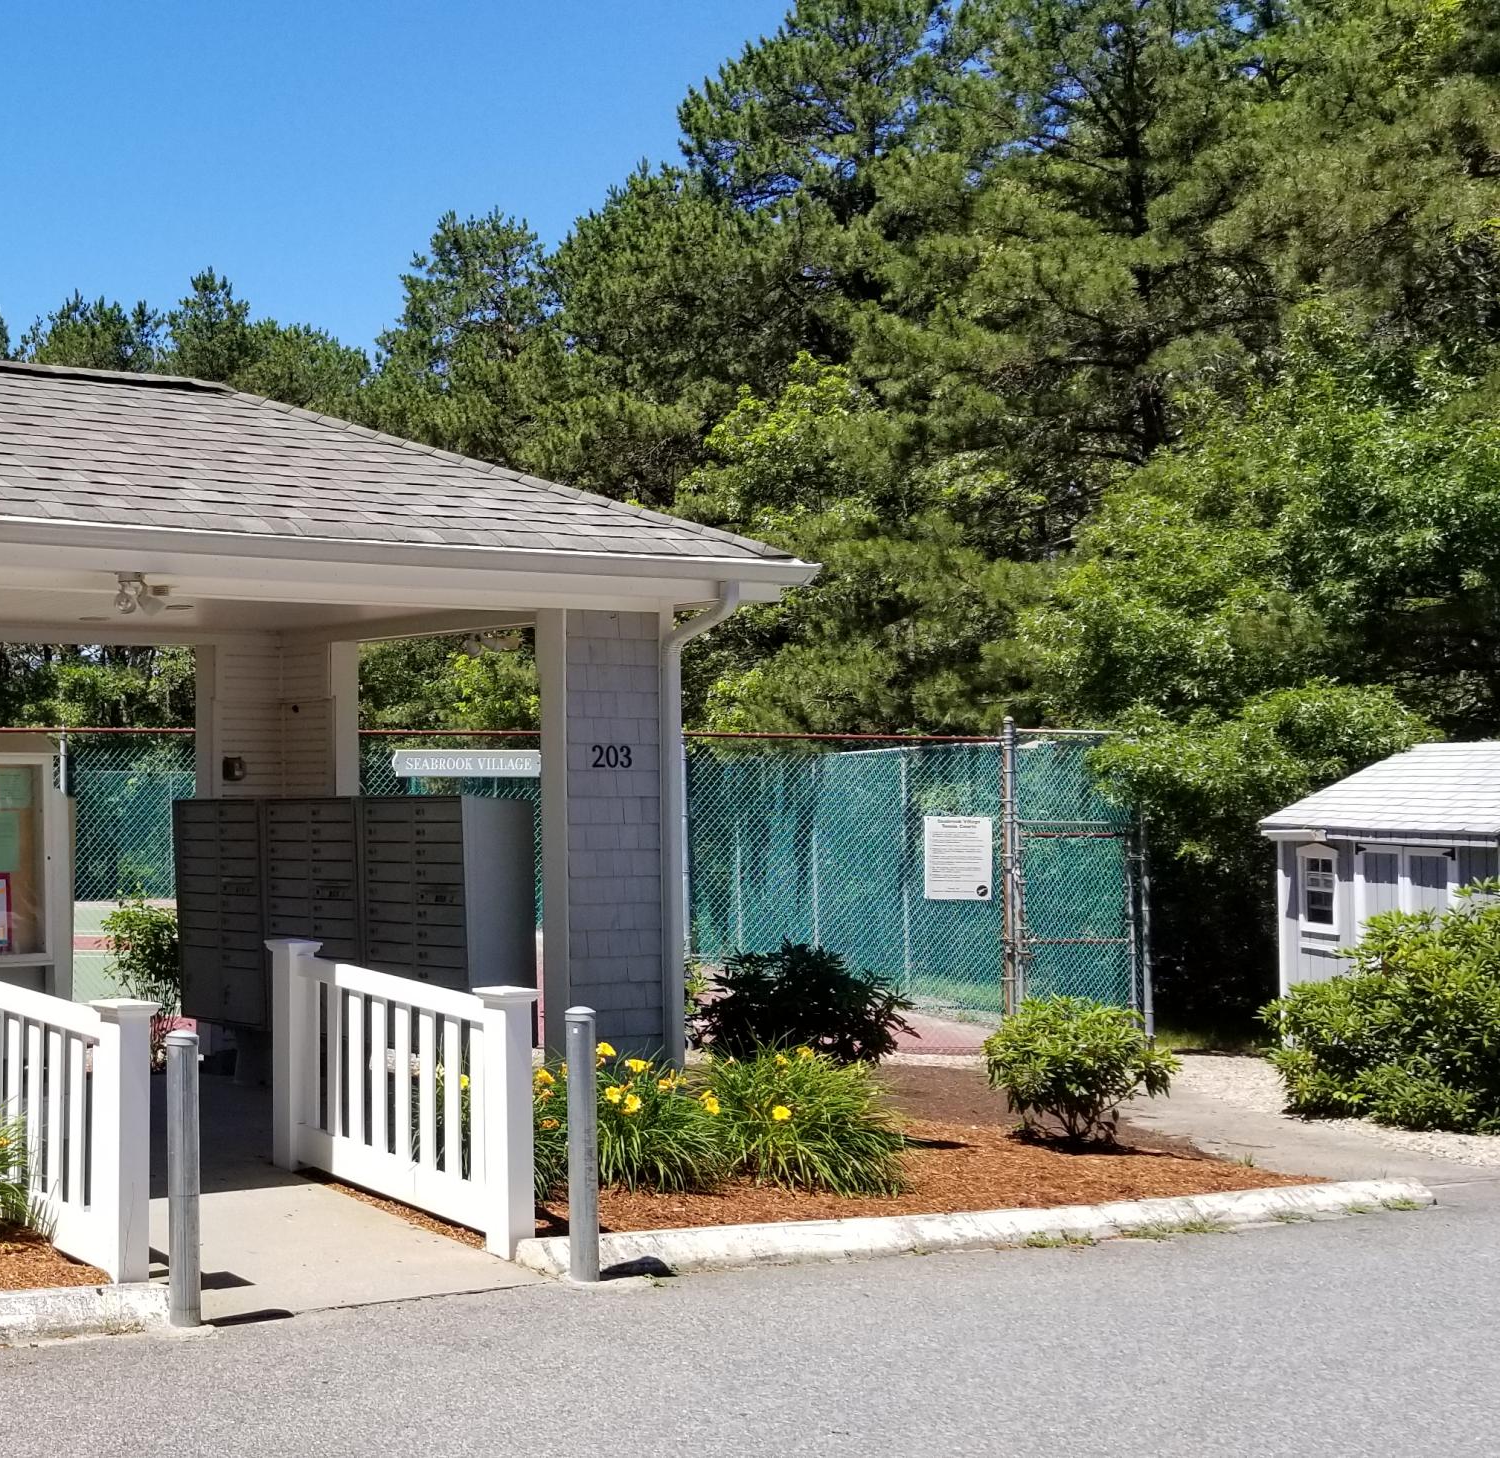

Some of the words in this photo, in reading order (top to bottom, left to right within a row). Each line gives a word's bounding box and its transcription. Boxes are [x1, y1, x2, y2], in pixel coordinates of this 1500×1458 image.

[405, 757, 473, 770] SEABROOK
[477, 757, 532, 770] VILLAGE
[591, 744, 632, 768] 203
